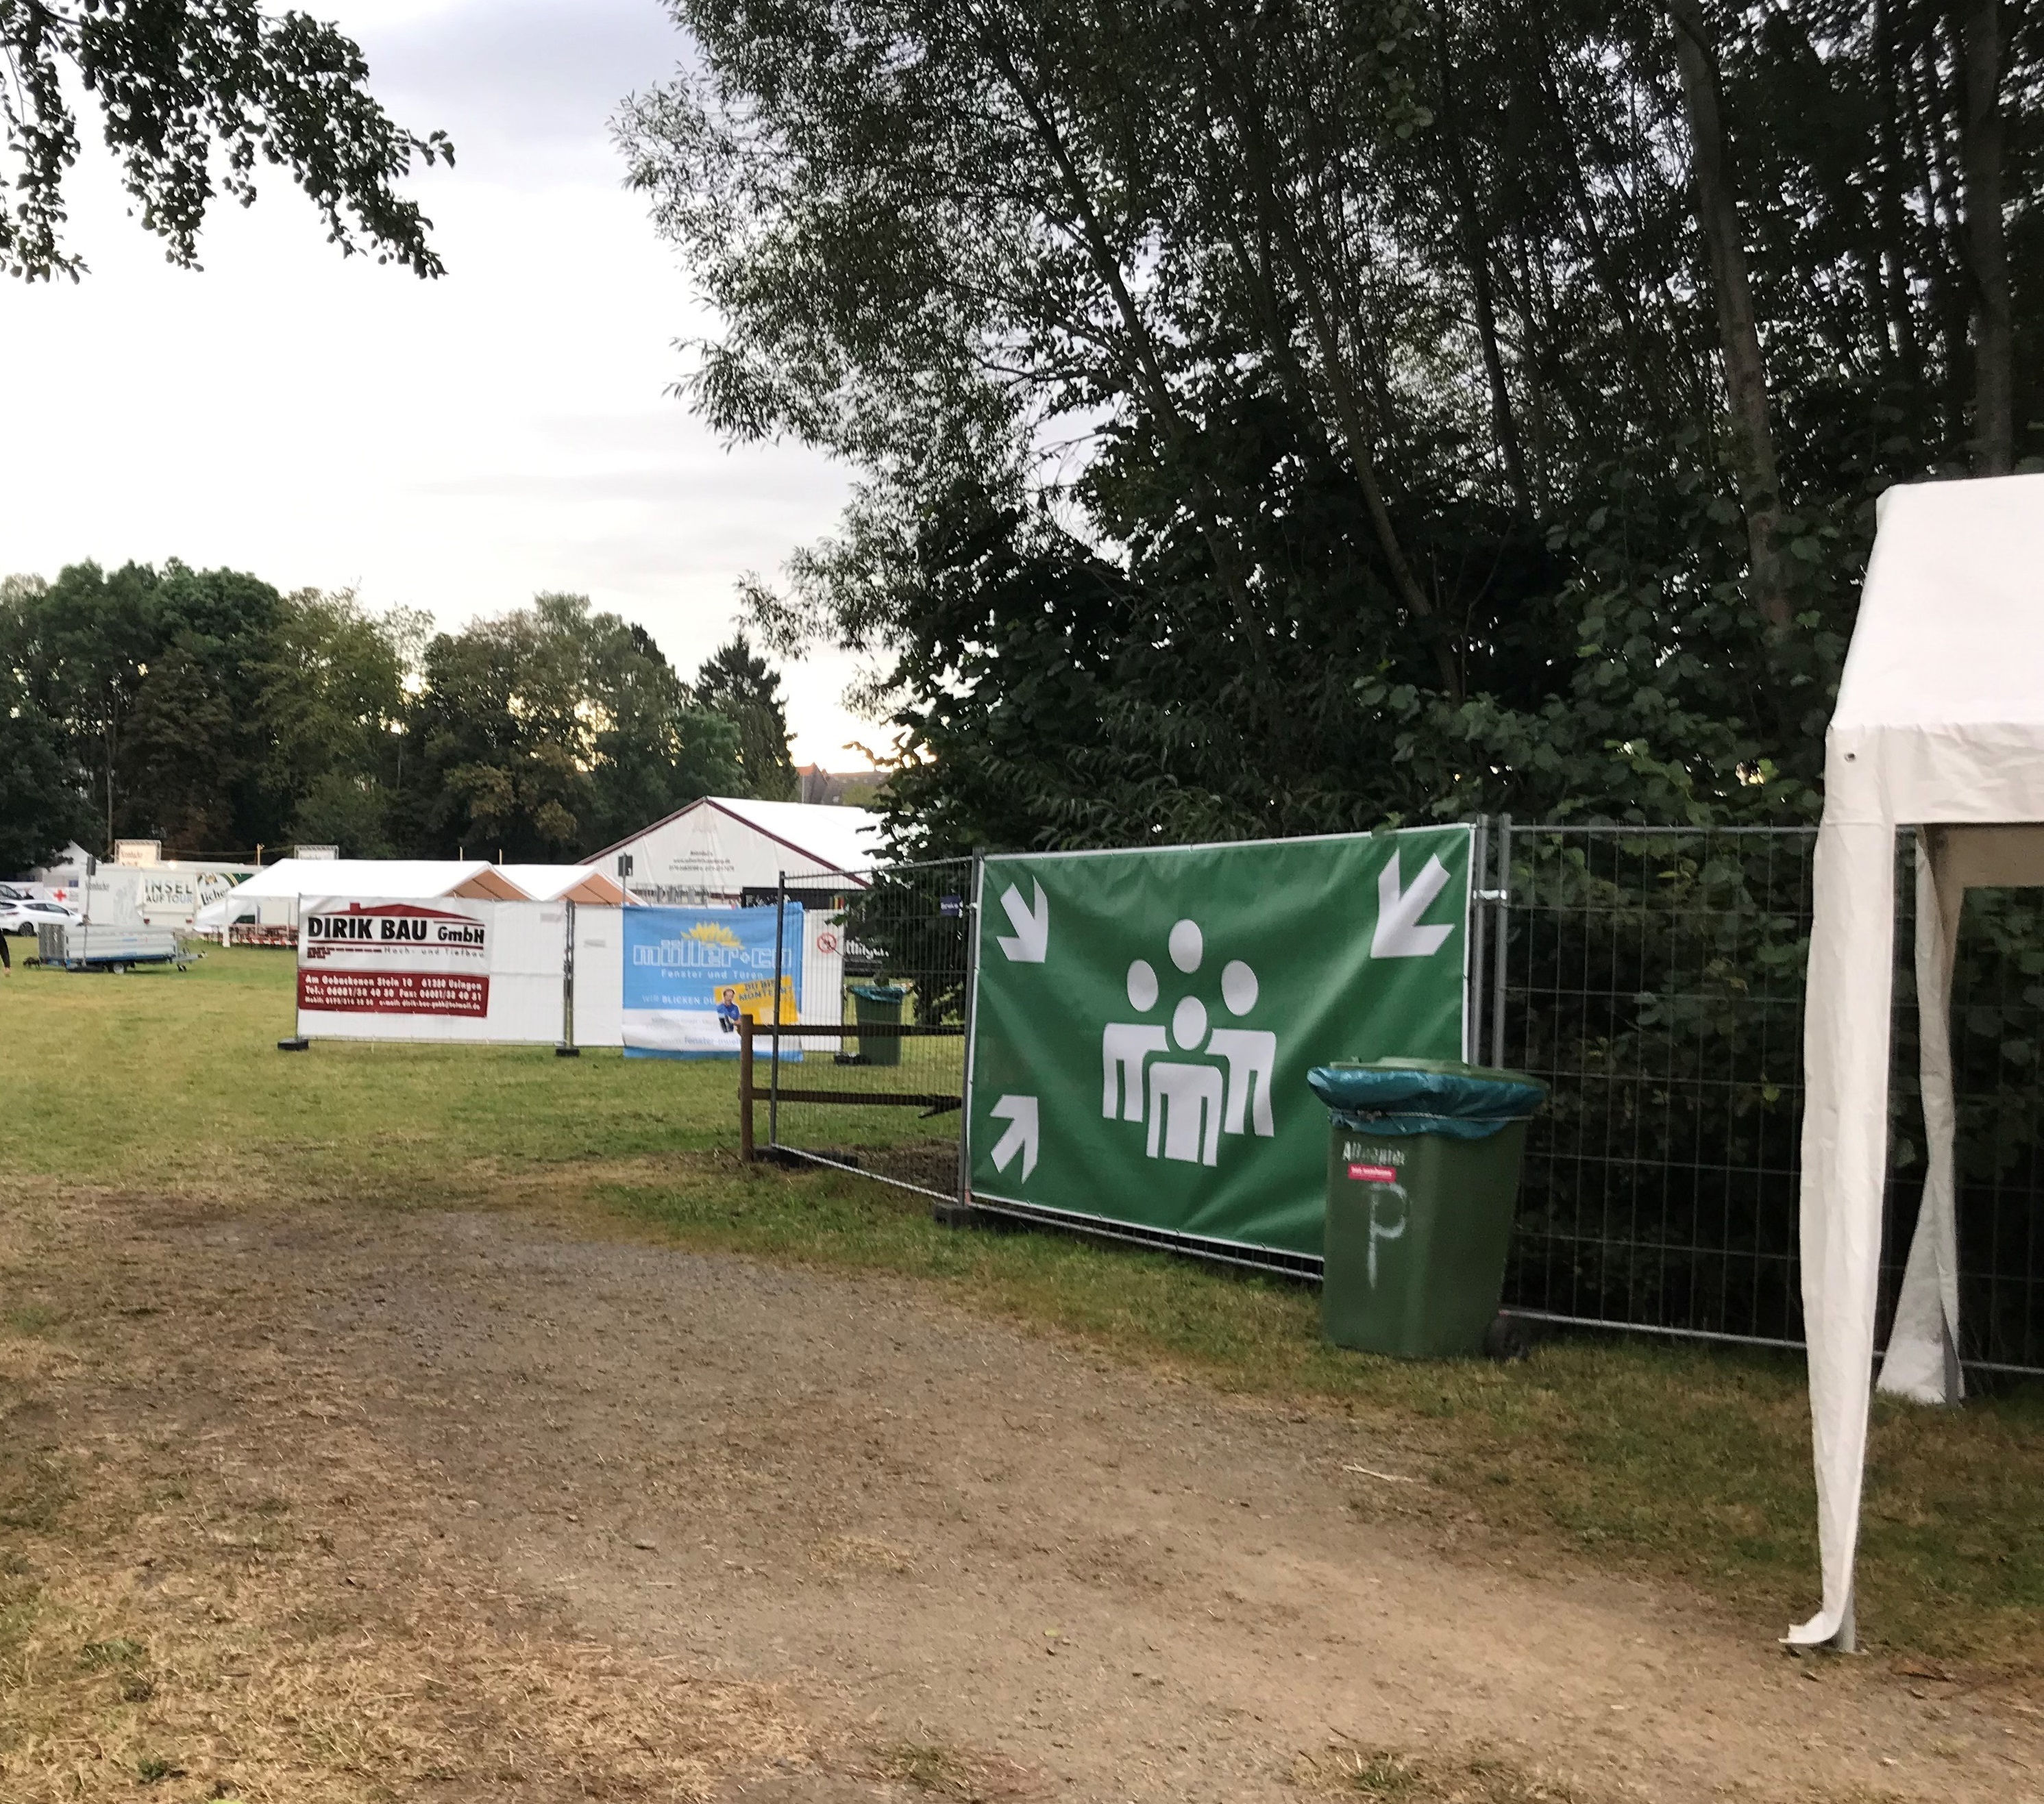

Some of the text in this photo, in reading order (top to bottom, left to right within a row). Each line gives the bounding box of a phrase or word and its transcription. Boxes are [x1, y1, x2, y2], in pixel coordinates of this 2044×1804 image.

[145, 879, 193, 894] INSEL
[146, 894, 193, 904] AUF TOUR
[308, 917, 485, 943] DIRIK BAU GmbH
[445, 948, 485, 958] Tiefbau
[661, 968, 702, 979] Fenster
[707, 969, 728, 979] und
[305, 974, 319, 985] Am
[377, 976, 399, 987] Stein
[642, 994, 660, 1003] WIR
[662, 995, 701, 1005] BLICKEN
